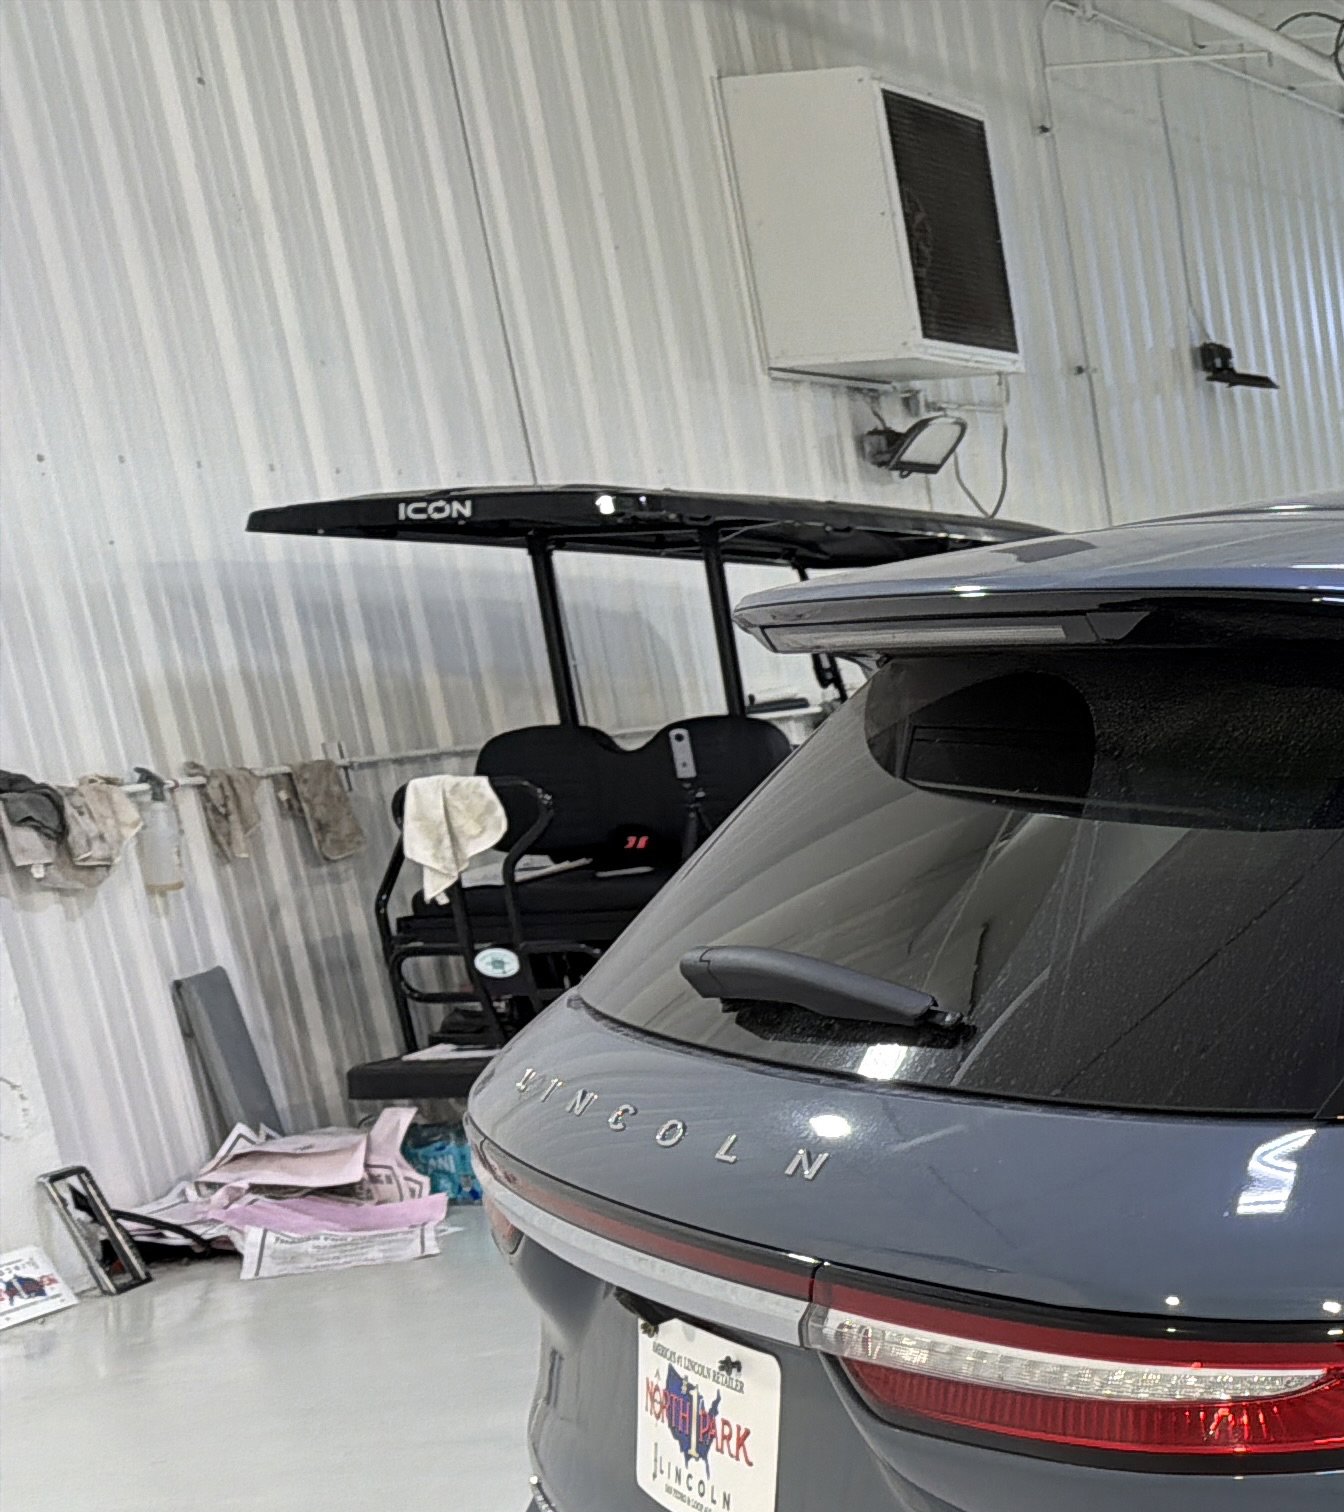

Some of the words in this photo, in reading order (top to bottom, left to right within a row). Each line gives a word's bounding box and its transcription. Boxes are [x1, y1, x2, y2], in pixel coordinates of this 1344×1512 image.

[398, 500, 472, 520] ICON
[516, 1068, 829, 1181] LINCOLN
[645, 1376, 689, 1437] NORTH
[700, 1406, 754, 1467] PARK
[659, 1455, 731, 1512] LINCOLN
